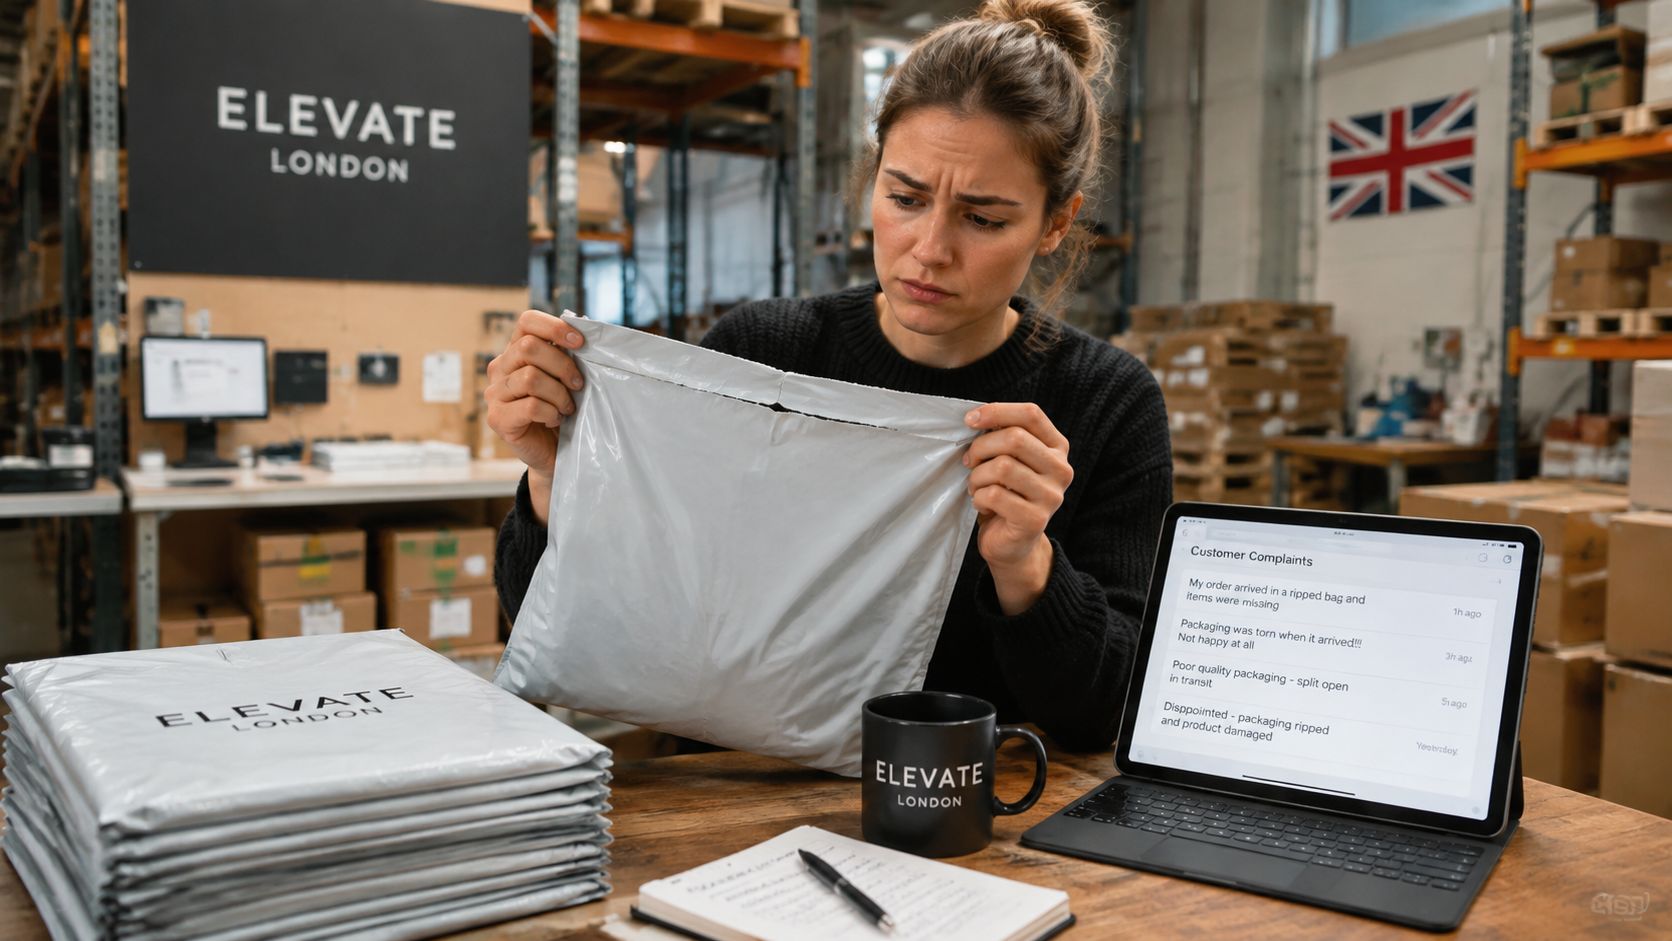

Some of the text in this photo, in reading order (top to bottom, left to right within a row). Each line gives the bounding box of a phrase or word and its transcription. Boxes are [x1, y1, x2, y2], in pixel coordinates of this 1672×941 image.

[217, 86, 456, 150] ELEVATE
[270, 147, 409, 183] LONDON
[1190, 545, 1313, 567] Customer Complaints
[1186, 592, 1280, 612] items were missing
[1189, 578, 1203, 589] My
[1206, 581, 1232, 591] order
[1234, 584, 1268, 595] arrived
[1270, 586, 1279, 596] in
[1290, 588, 1322, 600] ripped
[1324, 592, 1344, 604] bag
[1346, 595, 1366, 604] and
[1464, 610, 1482, 620] ago
[1178, 632, 1254, 650] Not happy at all
[1180, 618, 1362, 648] Packaging was torn when it arrived!!!
[1170, 674, 1213, 688] in transit
[1172, 660, 1196, 671] Poor
[1198, 664, 1232, 678] quality
[1234, 669, 1287, 686] packaging
[1296, 677, 1319, 688] split
[1322, 681, 1349, 692] open
[155, 686, 415, 728] ELEVATE
[231, 706, 383, 732] LONDON
[1160, 717, 1273, 742] and product damaged
[1238, 714, 1292, 731] packaging
[1294, 721, 1330, 735] ripped
[876, 760, 984, 789] ELEVATE
[897, 794, 962, 808] LONDON
